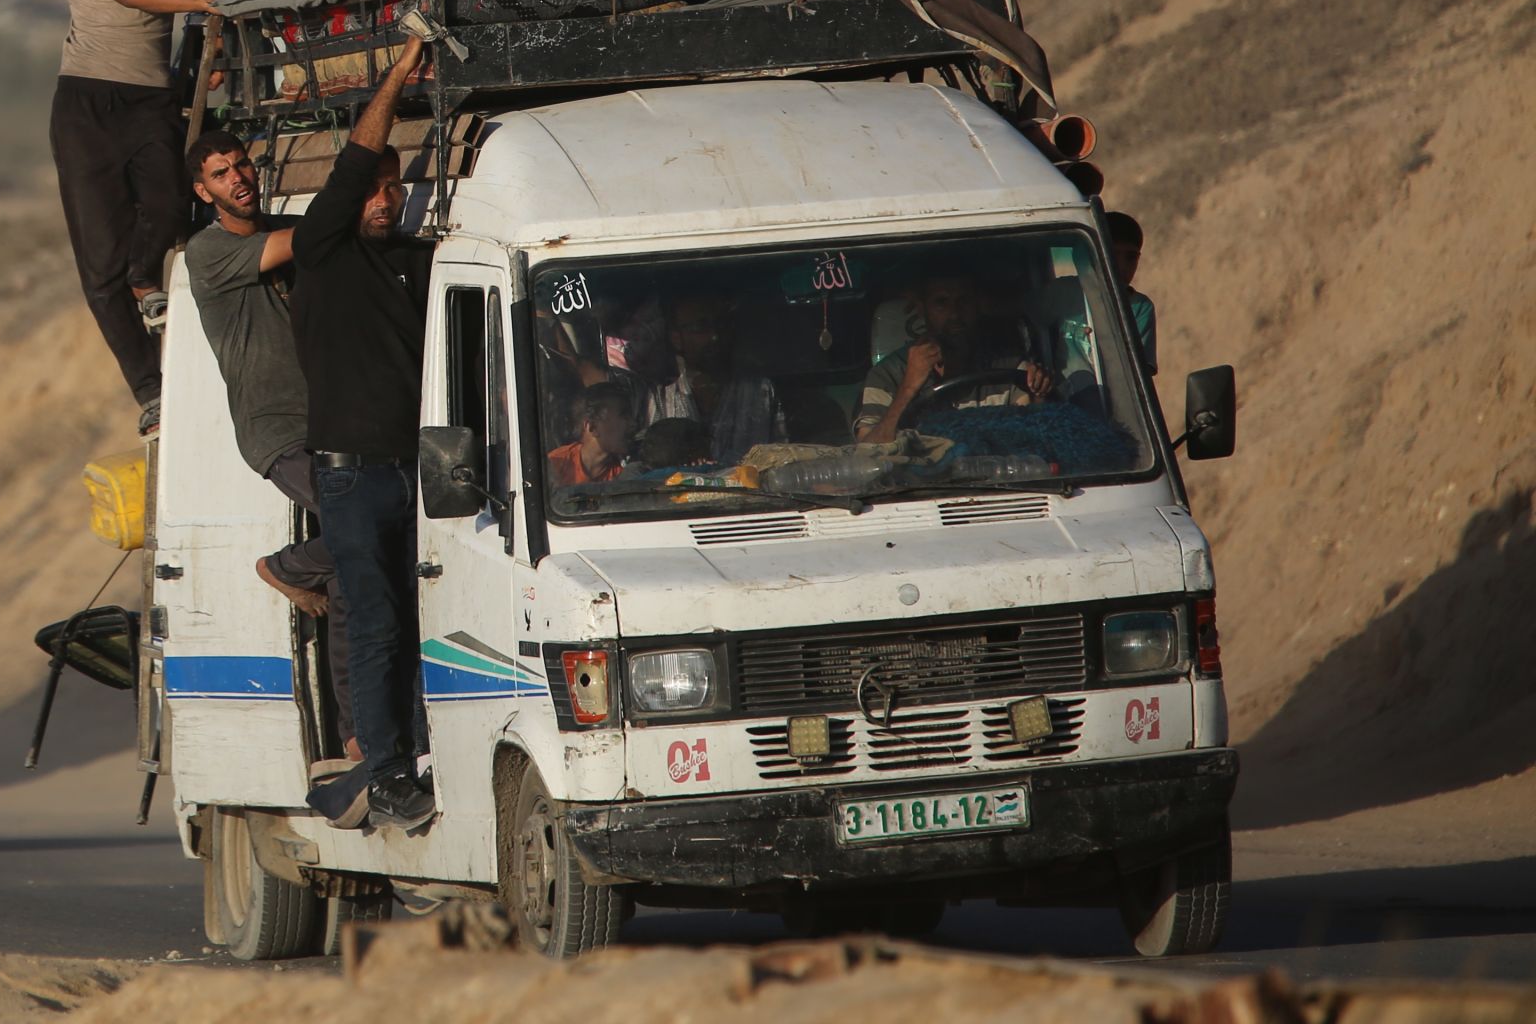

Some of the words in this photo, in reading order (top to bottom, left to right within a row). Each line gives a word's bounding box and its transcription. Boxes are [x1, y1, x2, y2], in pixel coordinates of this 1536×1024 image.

[551, 272, 592, 315] الله
[1125, 696, 1161, 744] 01
[667, 738, 711, 783] 01
[846, 795, 990, 835] 3-1184-12
